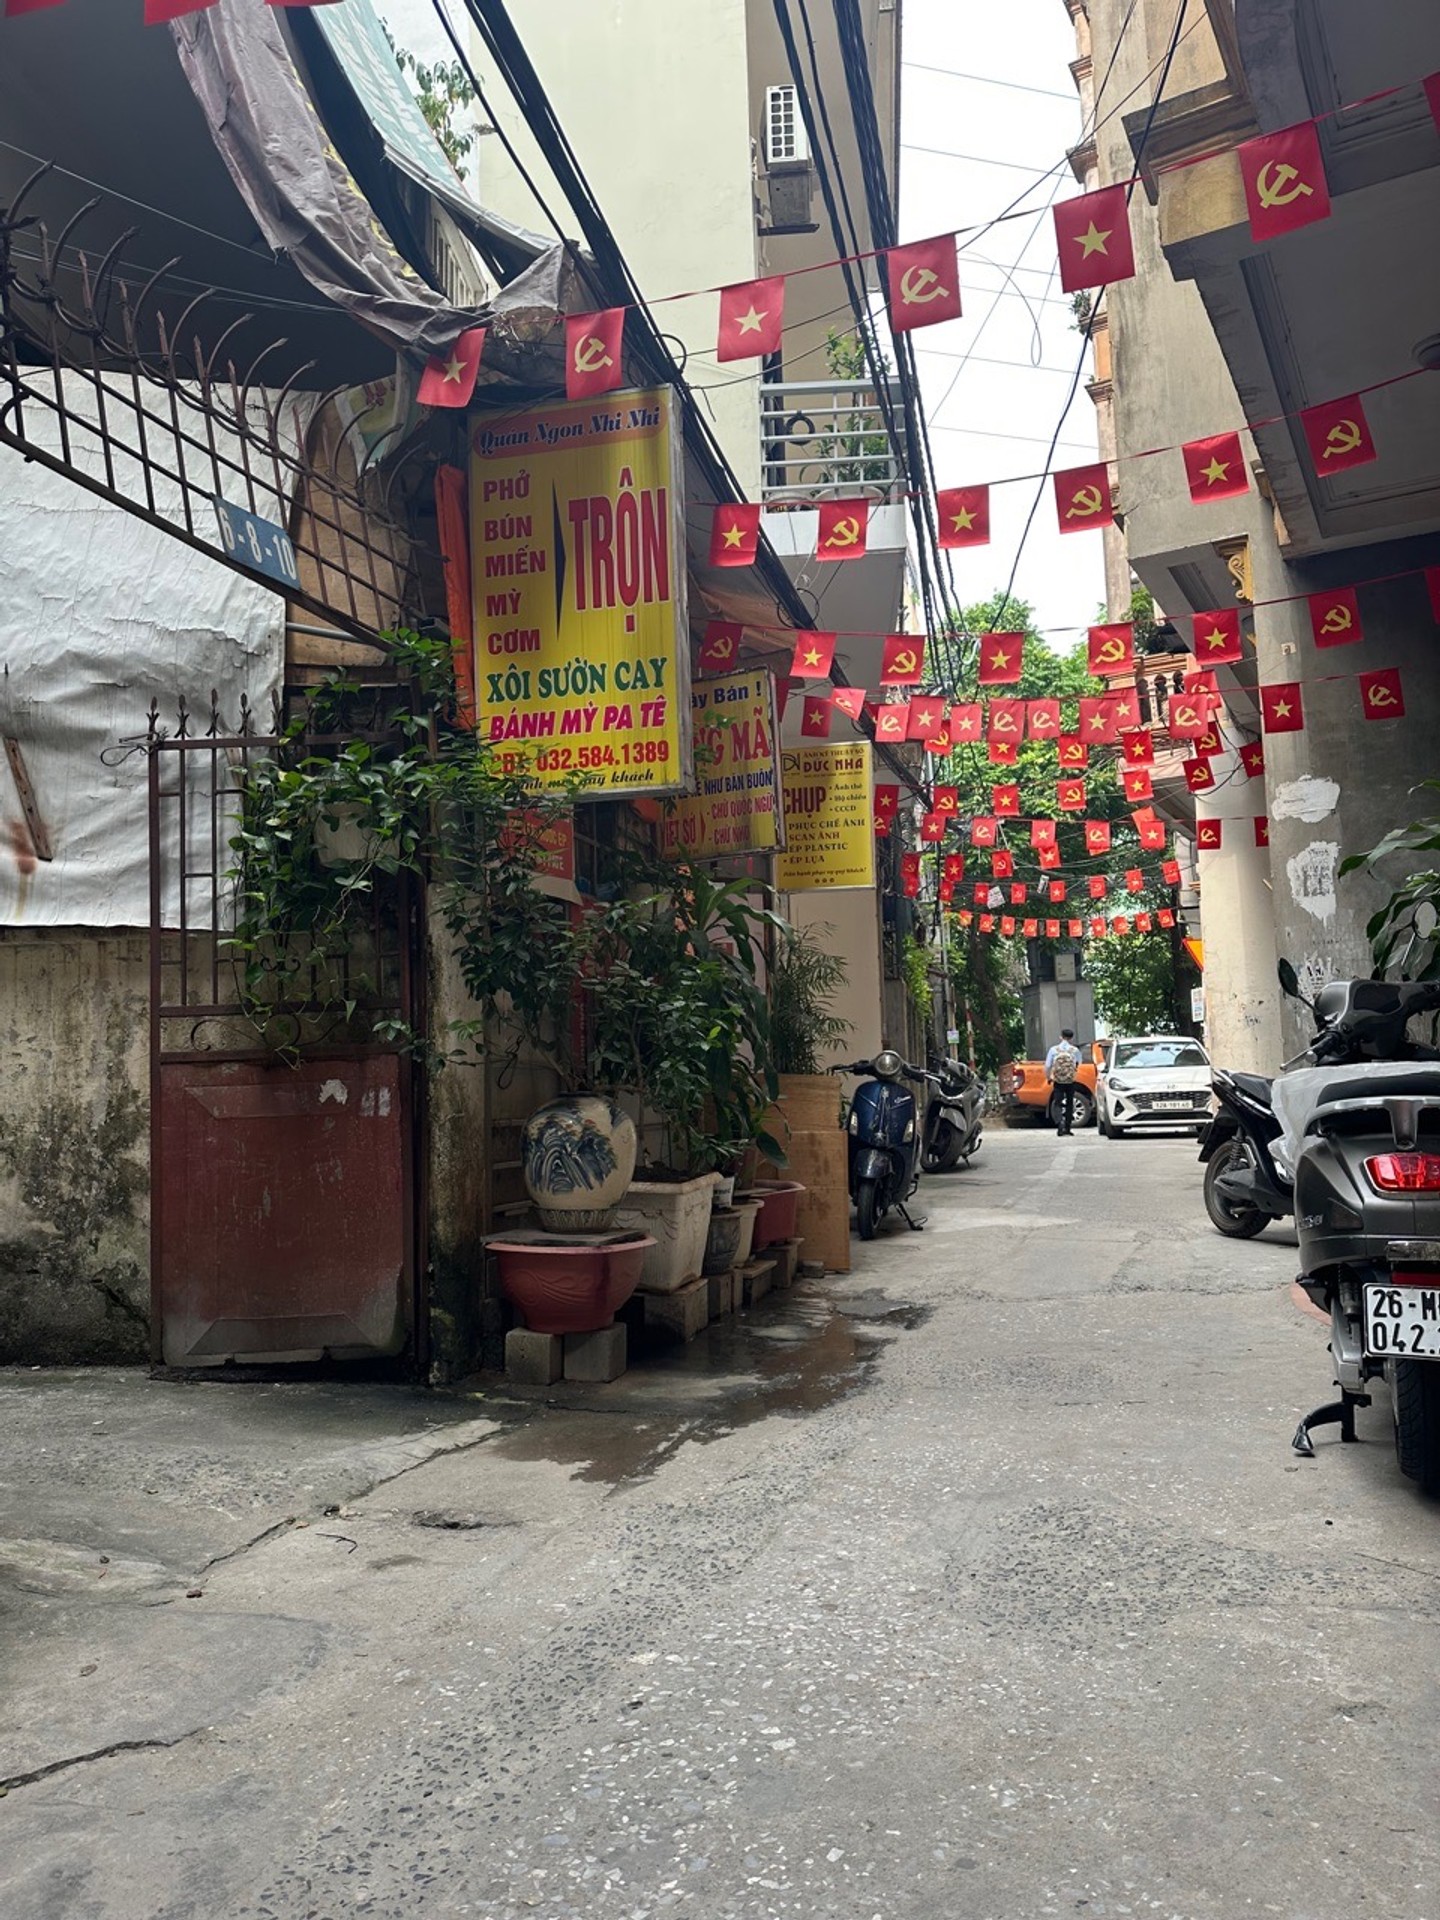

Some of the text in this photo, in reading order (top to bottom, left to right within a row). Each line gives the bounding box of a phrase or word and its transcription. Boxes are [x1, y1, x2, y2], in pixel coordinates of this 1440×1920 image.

[480, 406, 660, 455] Quán Ngon Nhi Nhi
[483, 469, 531, 502] PHỞ
[219, 507, 296, 580] 6-8-10
[484, 513, 532, 542] BÚN
[485, 544, 546, 578] MIẾN
[568, 466, 670, 633] TRỘN
[486, 588, 522, 617] MỲ
[487, 628, 541, 655] CƠM
[487, 657, 668, 703] XÔI SƯỜN CAY
[714, 685, 748, 704] Bán
[489, 707, 556, 741] BÁNH
[602, 704, 633, 731] PA
[640, 695, 667, 728] TÊ
[730, 705, 771, 763] MÃ
[536, 740, 670, 773] 032.584.1389
[704, 776, 723, 795] NHƯ
[783, 786, 827, 818] CHỤP
[789, 821, 816, 830] PHỤC
[789, 833, 815, 841] SCAN
[790, 856, 802, 864] ÉP
[805, 842, 848, 852] PLASTIC
[1372, 1289, 1440, 1320] 26-M
[1372, 1321, 1440, 1354] 042.
